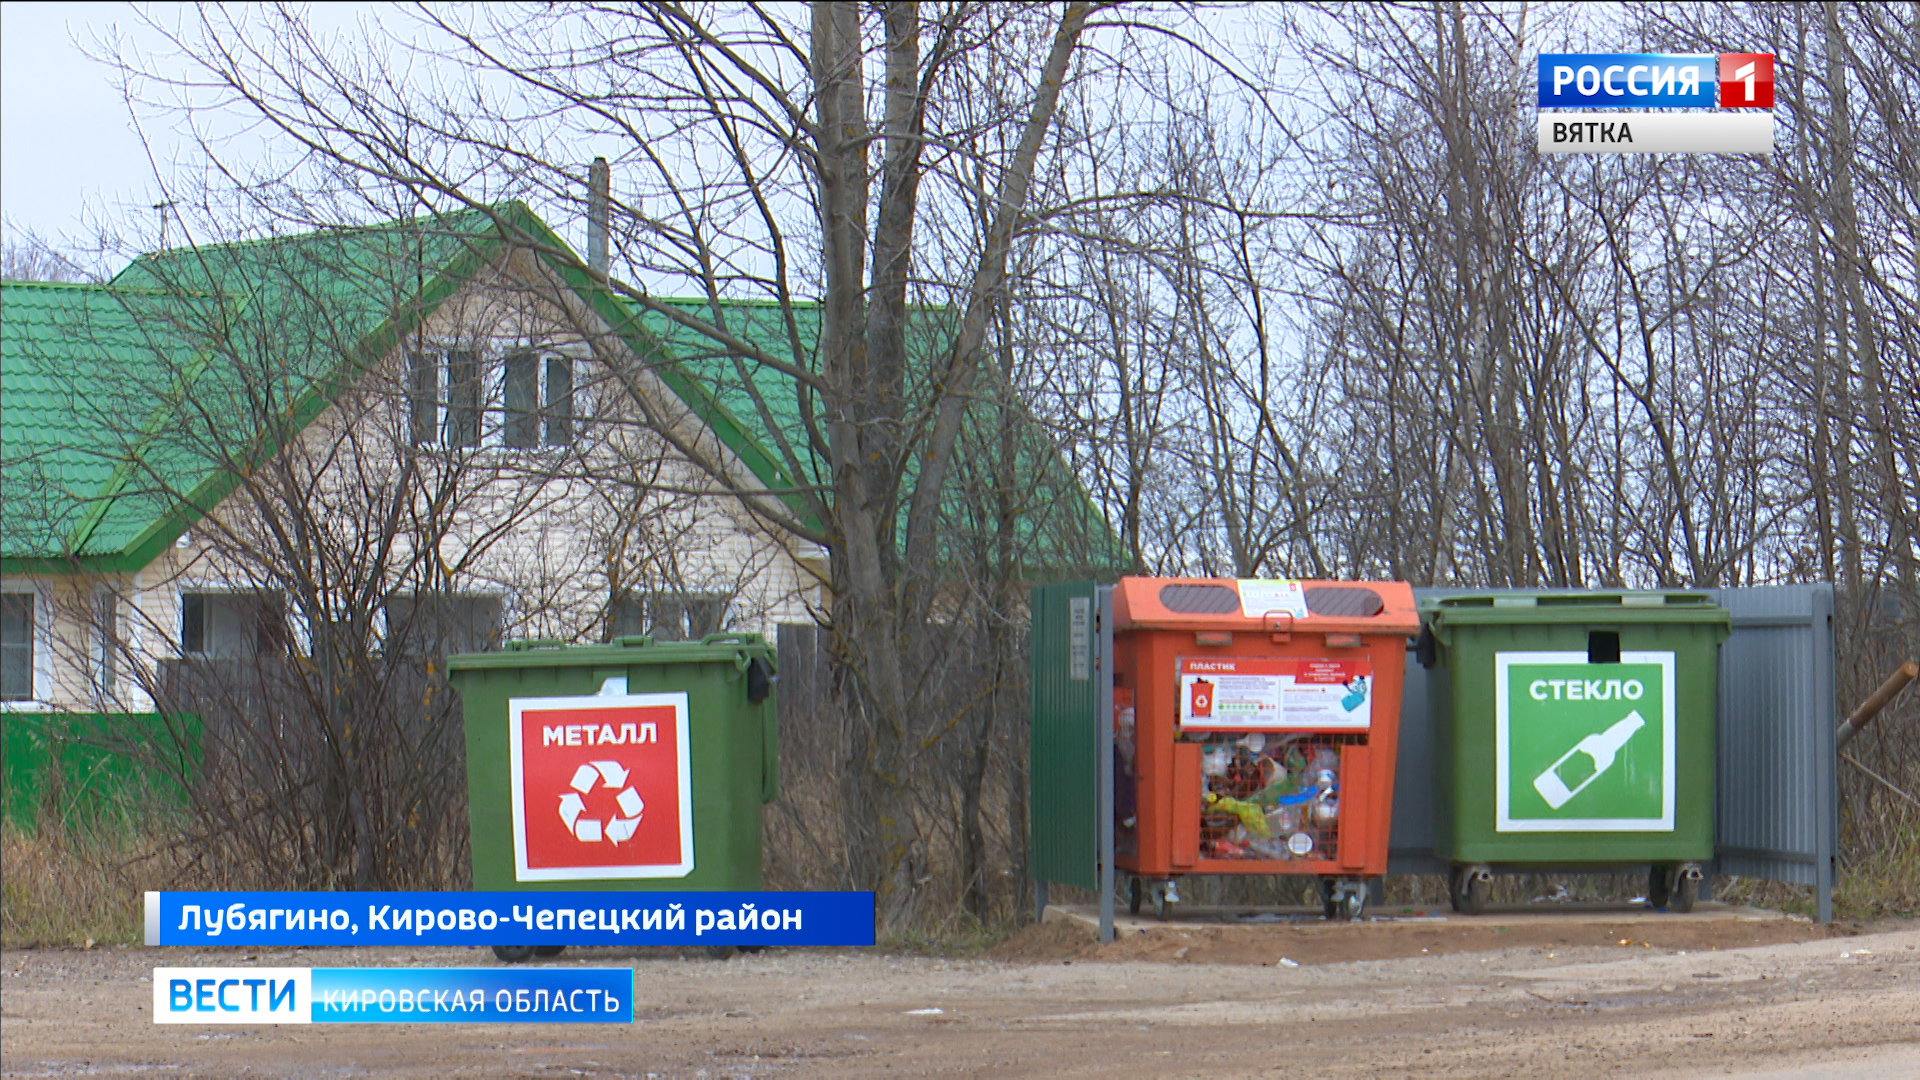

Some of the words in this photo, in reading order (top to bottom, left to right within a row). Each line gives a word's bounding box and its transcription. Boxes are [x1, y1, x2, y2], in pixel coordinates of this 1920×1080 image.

[1189, 661, 1236, 672] ПЛАСТИК
[1529, 679, 1645, 701] СТЕКЛО
[543, 722, 658, 747] МЕТАЛЛ
